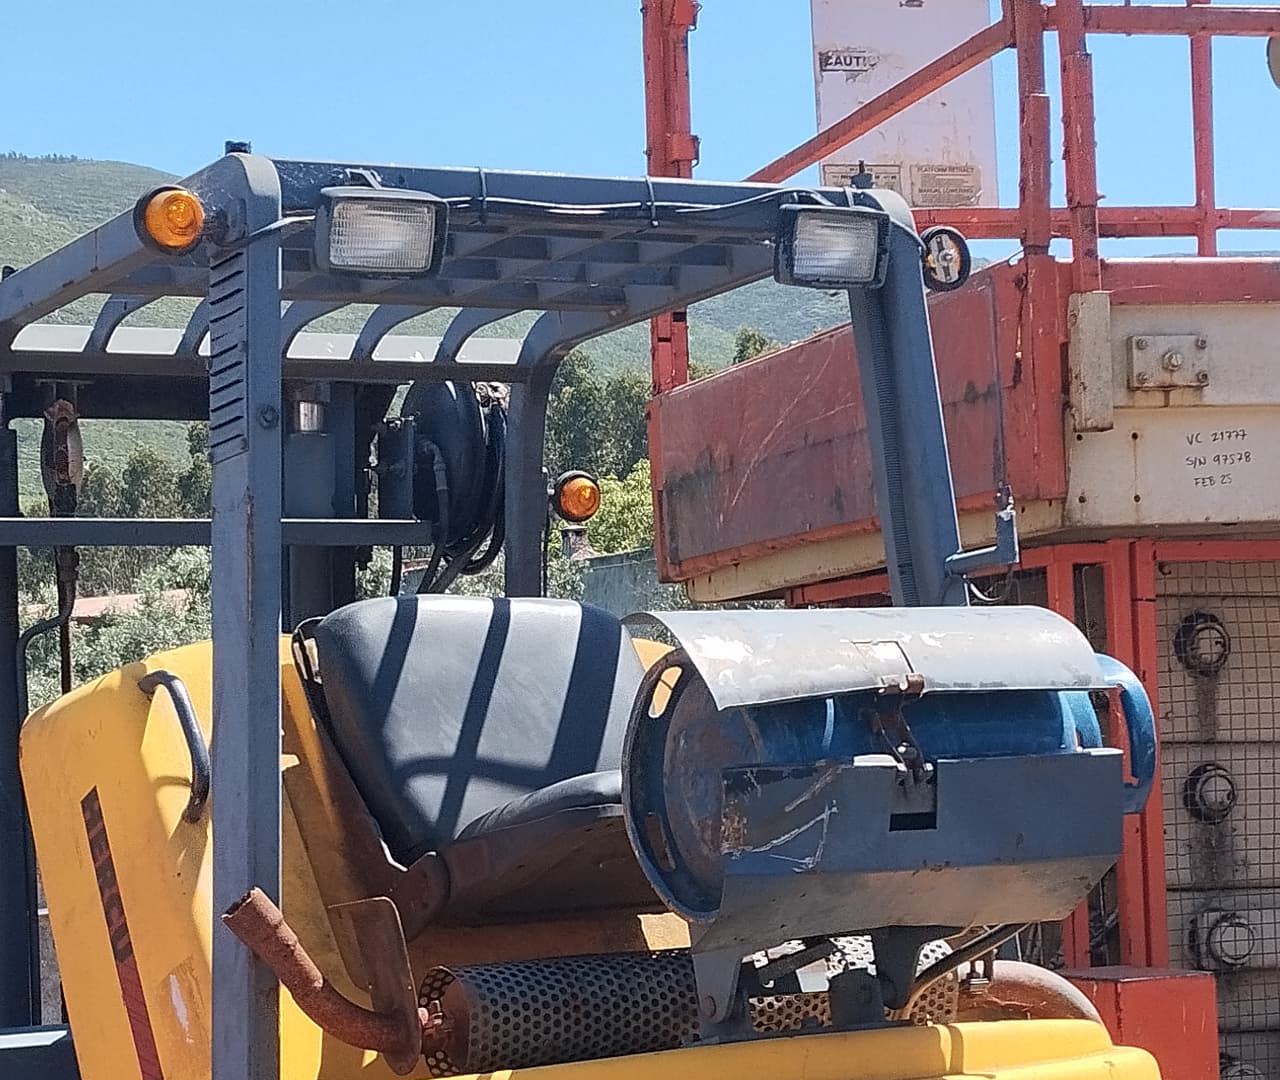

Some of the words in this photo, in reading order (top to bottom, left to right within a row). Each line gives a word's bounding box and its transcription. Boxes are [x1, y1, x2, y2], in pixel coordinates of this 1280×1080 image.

[1186, 432, 1203, 446] VC
[1185, 456, 1207, 469] S/N
[1212, 451, 1252, 466] 97578
[1193, 476, 1216, 488] FEB
